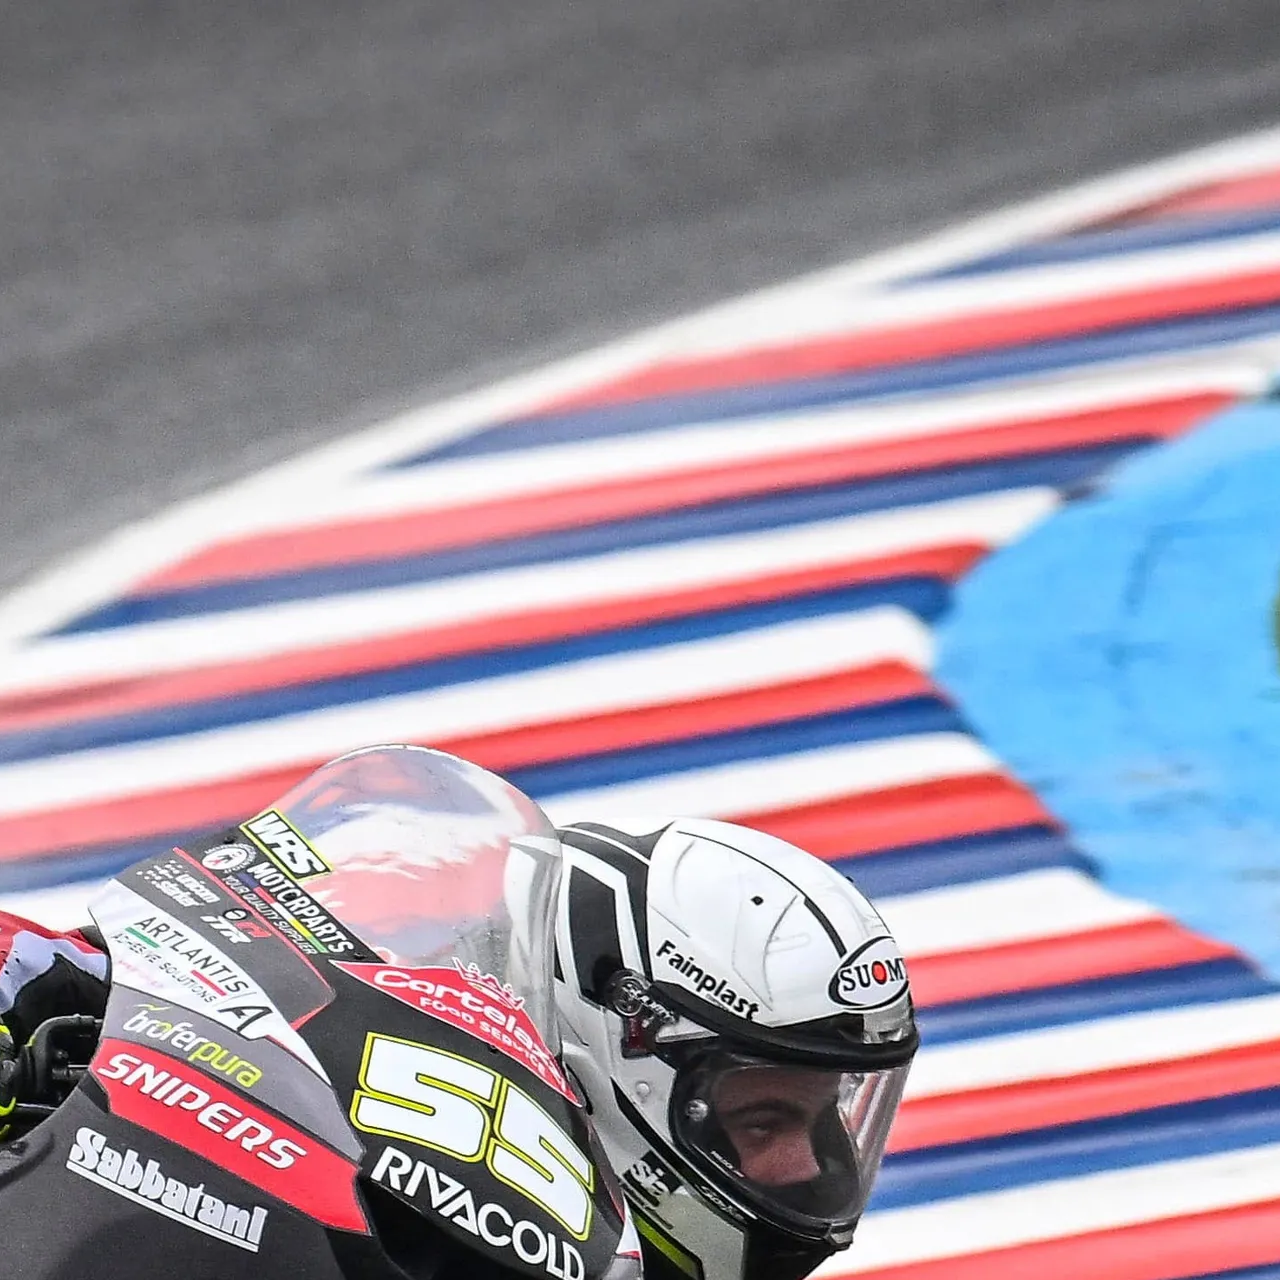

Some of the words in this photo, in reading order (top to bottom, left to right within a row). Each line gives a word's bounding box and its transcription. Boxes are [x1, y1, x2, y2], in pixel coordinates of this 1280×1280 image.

[248, 812, 327, 874] WRS
[134, 917, 249, 993] ARTLANTIS
[159, 962, 218, 1003] SOLUTIONS
[656, 940, 759, 1021] Fainplast
[840, 957, 905, 992] SUOM
[420, 997, 475, 1025] FOOD
[478, 1021, 548, 1079] SERVICE
[97, 1053, 307, 1170] SNIPERS
[350, 1032, 594, 1241] 55
